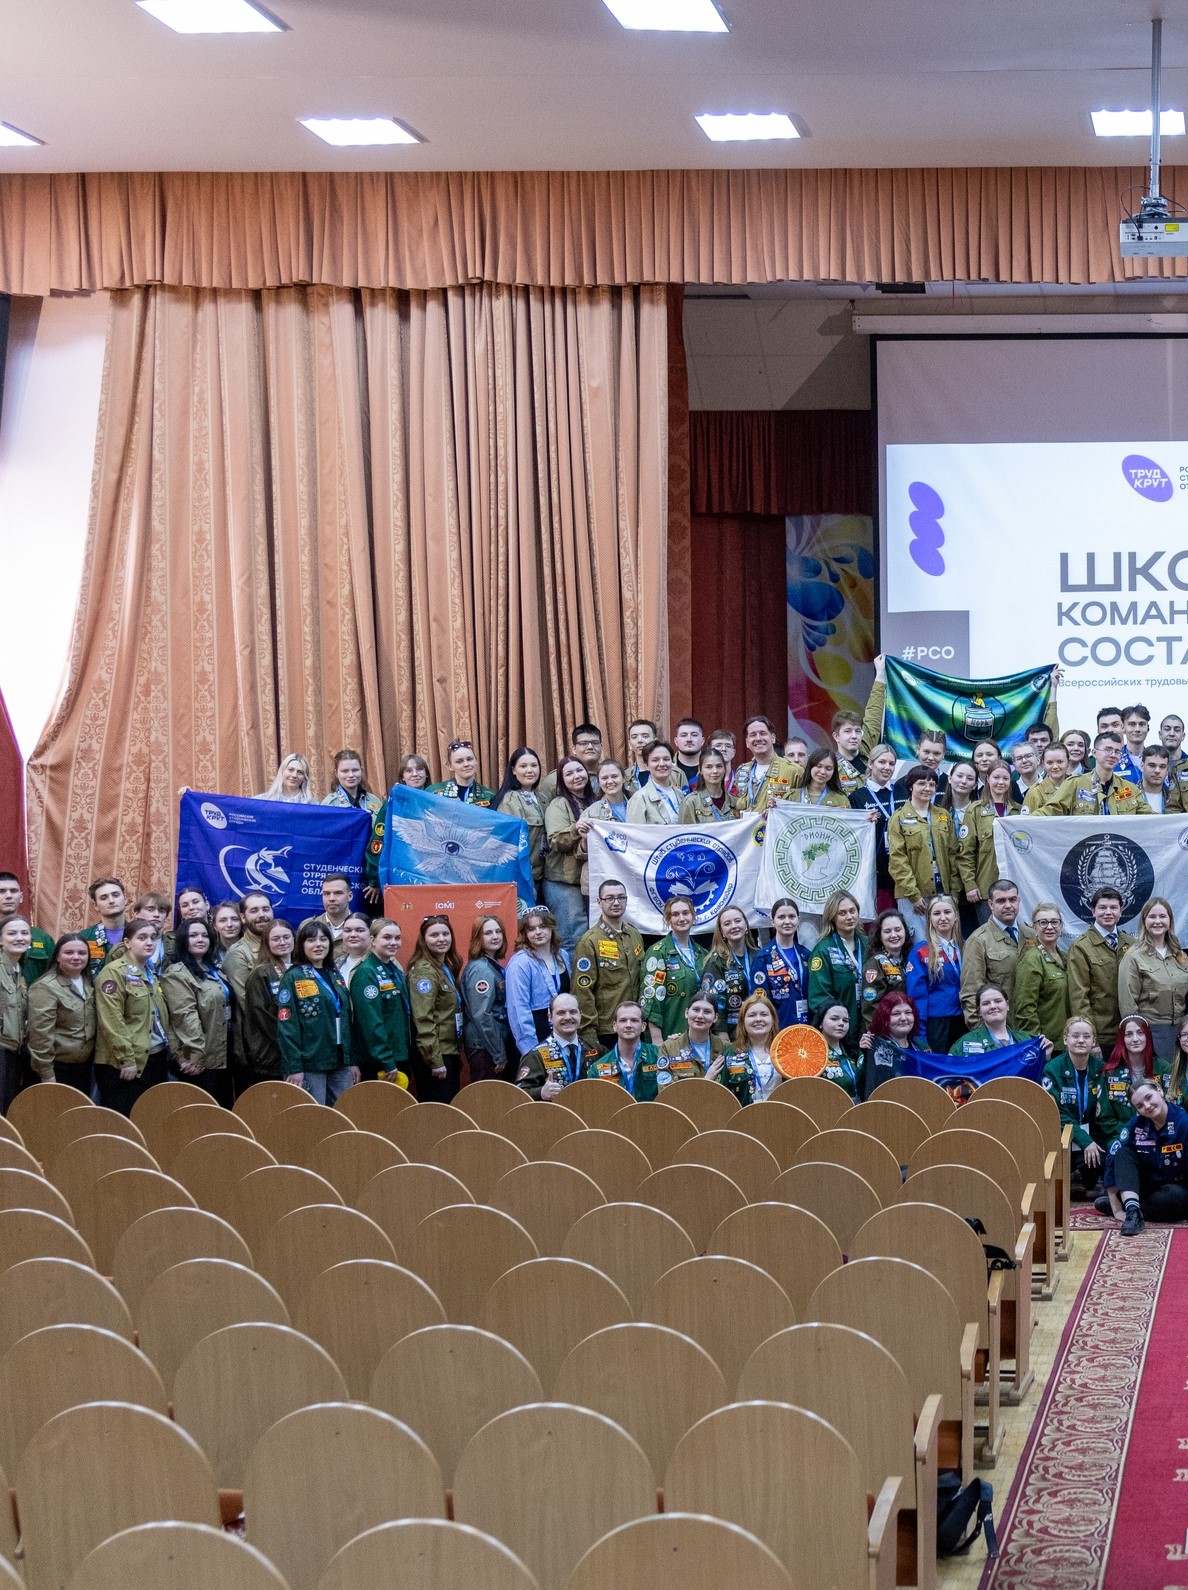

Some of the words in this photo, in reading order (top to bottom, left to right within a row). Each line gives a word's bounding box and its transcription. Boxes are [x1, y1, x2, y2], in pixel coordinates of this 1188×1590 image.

[1129, 469, 1162, 479] ТРУД
[1134, 478, 1168, 488] КРУТ
[901, 645, 955, 660] #РСО
[1058, 677, 1142, 689] Всероссийских
[204, 809, 222, 817] ТРУД
[666, 836, 712, 851] студенческих
[712, 842, 734, 864] отрядов
